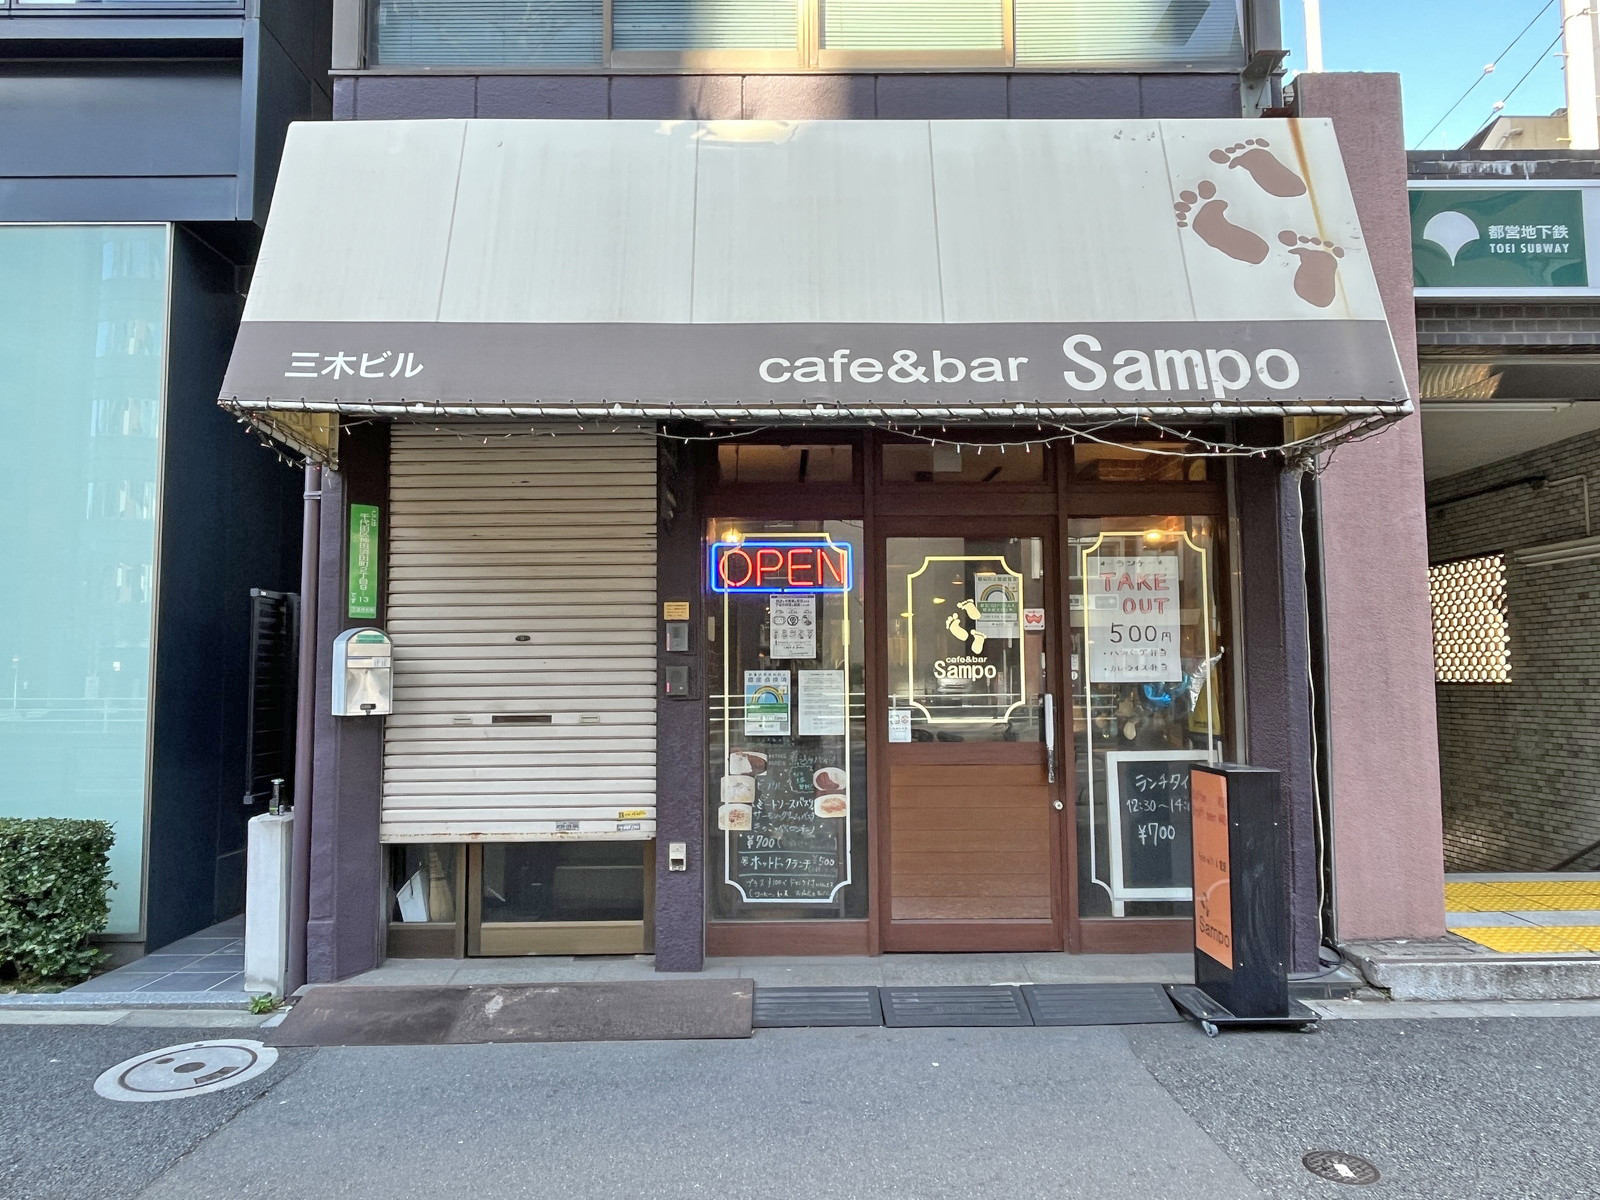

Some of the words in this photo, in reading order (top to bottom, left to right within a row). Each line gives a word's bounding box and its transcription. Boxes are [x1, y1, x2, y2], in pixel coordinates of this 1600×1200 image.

[1488, 224, 1569, 240] 都営地下鉄
[1489, 243, 1516, 254] TOEI
[1520, 243, 1570, 254] SUBWAY
[284, 349, 425, 380] 三木ビル
[758, 348, 1028, 384] cafe&bar
[1063, 333, 1301, 399] Sampo
[718, 547, 845, 587] OPEN
[1099, 571, 1170, 592] TAKE
[1122, 597, 1170, 615] OUT
[1109, 622, 1172, 643] 500円
[945, 655, 988, 664] cafe&bar
[933, 660, 997, 682] Sampo
[1135, 773, 1189, 792] ランチタイ
[1138, 822, 1176, 847] ¥700
[1198, 915, 1230, 949] Sampo
